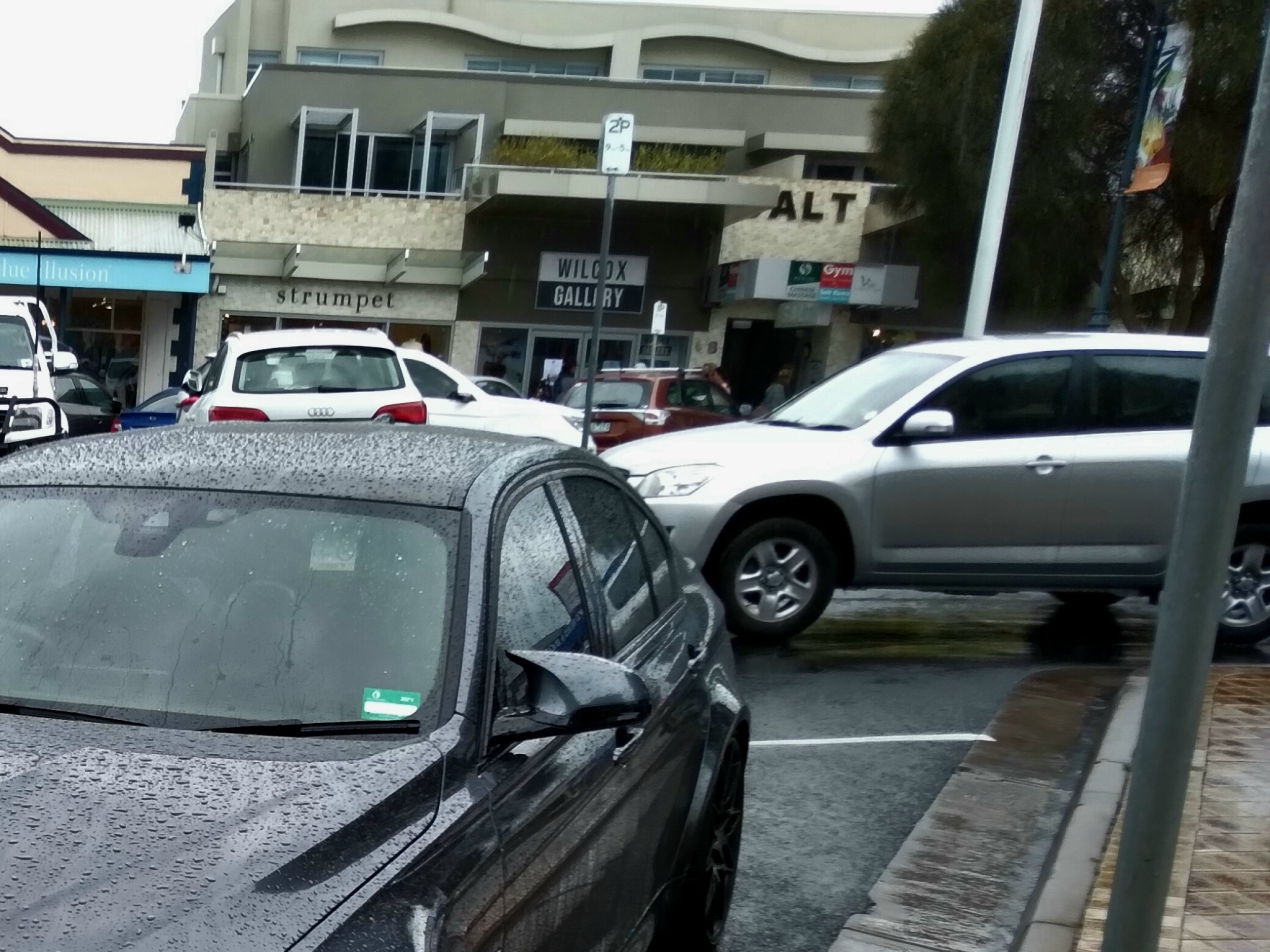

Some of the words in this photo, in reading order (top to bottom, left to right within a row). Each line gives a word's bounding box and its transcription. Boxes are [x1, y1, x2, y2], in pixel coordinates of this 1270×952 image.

[609, 119, 630, 133] 2P
[38, 260, 109, 283] llusion
[823, 264, 854, 278] Gym
[276, 288, 395, 314] strumpet
